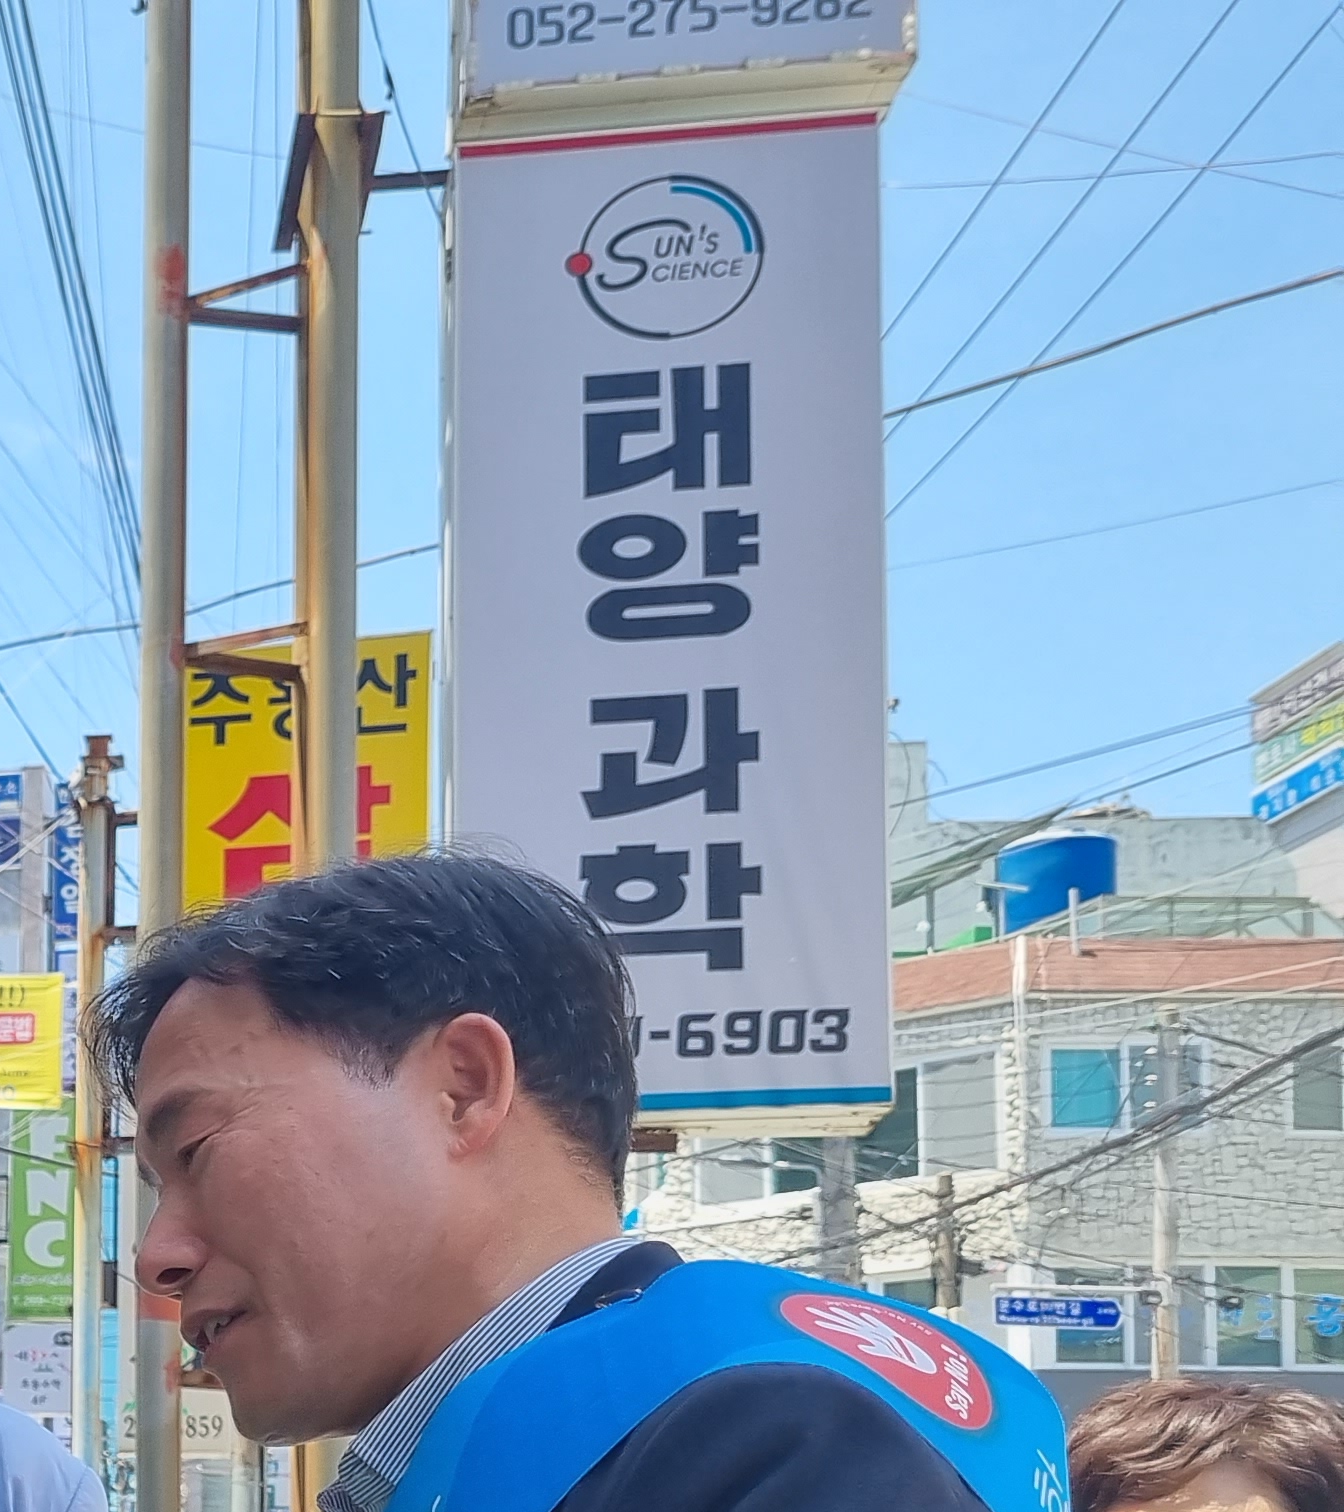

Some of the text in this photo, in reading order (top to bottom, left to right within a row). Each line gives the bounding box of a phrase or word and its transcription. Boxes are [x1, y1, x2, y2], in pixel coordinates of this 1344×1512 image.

[580, 360, 764, 973] 태양과학
[631, 1006, 849, 1058] -6903
[940, 1342, 974, 1421] Say No!
